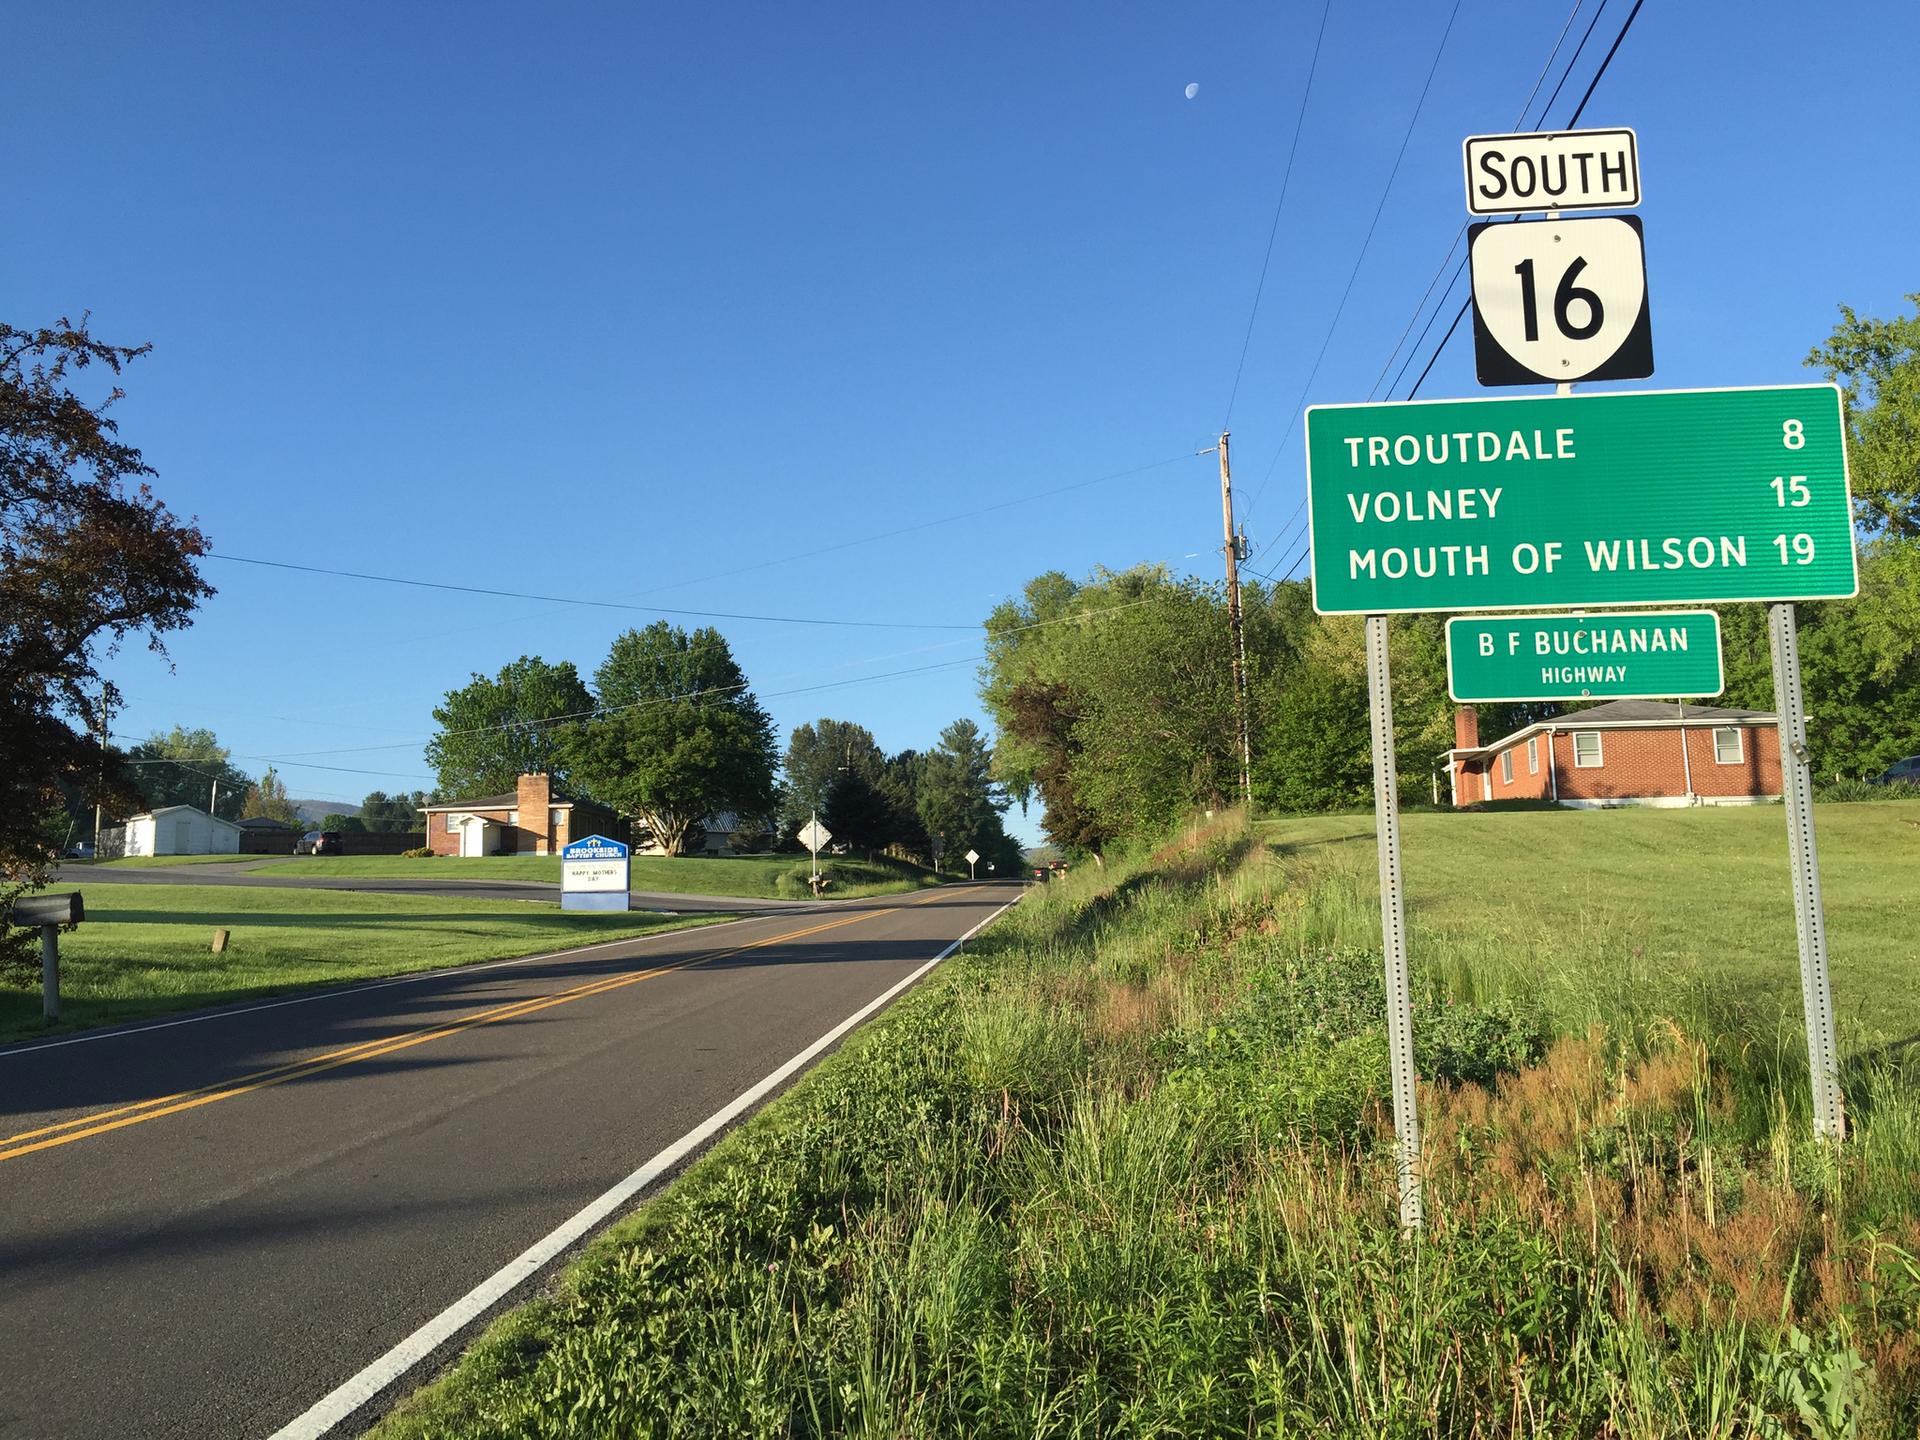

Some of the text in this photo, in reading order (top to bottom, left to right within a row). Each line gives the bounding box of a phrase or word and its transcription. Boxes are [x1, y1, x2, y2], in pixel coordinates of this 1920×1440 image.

[1479, 150, 1628, 200] SOUTH
[1514, 255, 1605, 342] 16
[1344, 418, 1806, 468] TROUTDALE 8
[1347, 475, 1812, 524] VOLNEY 15
[1348, 532, 1816, 580] MOUTH OF WILSON 19
[1478, 626, 1689, 656] B F BUCHANAN
[1541, 665, 1627, 685] HIGHWAY
